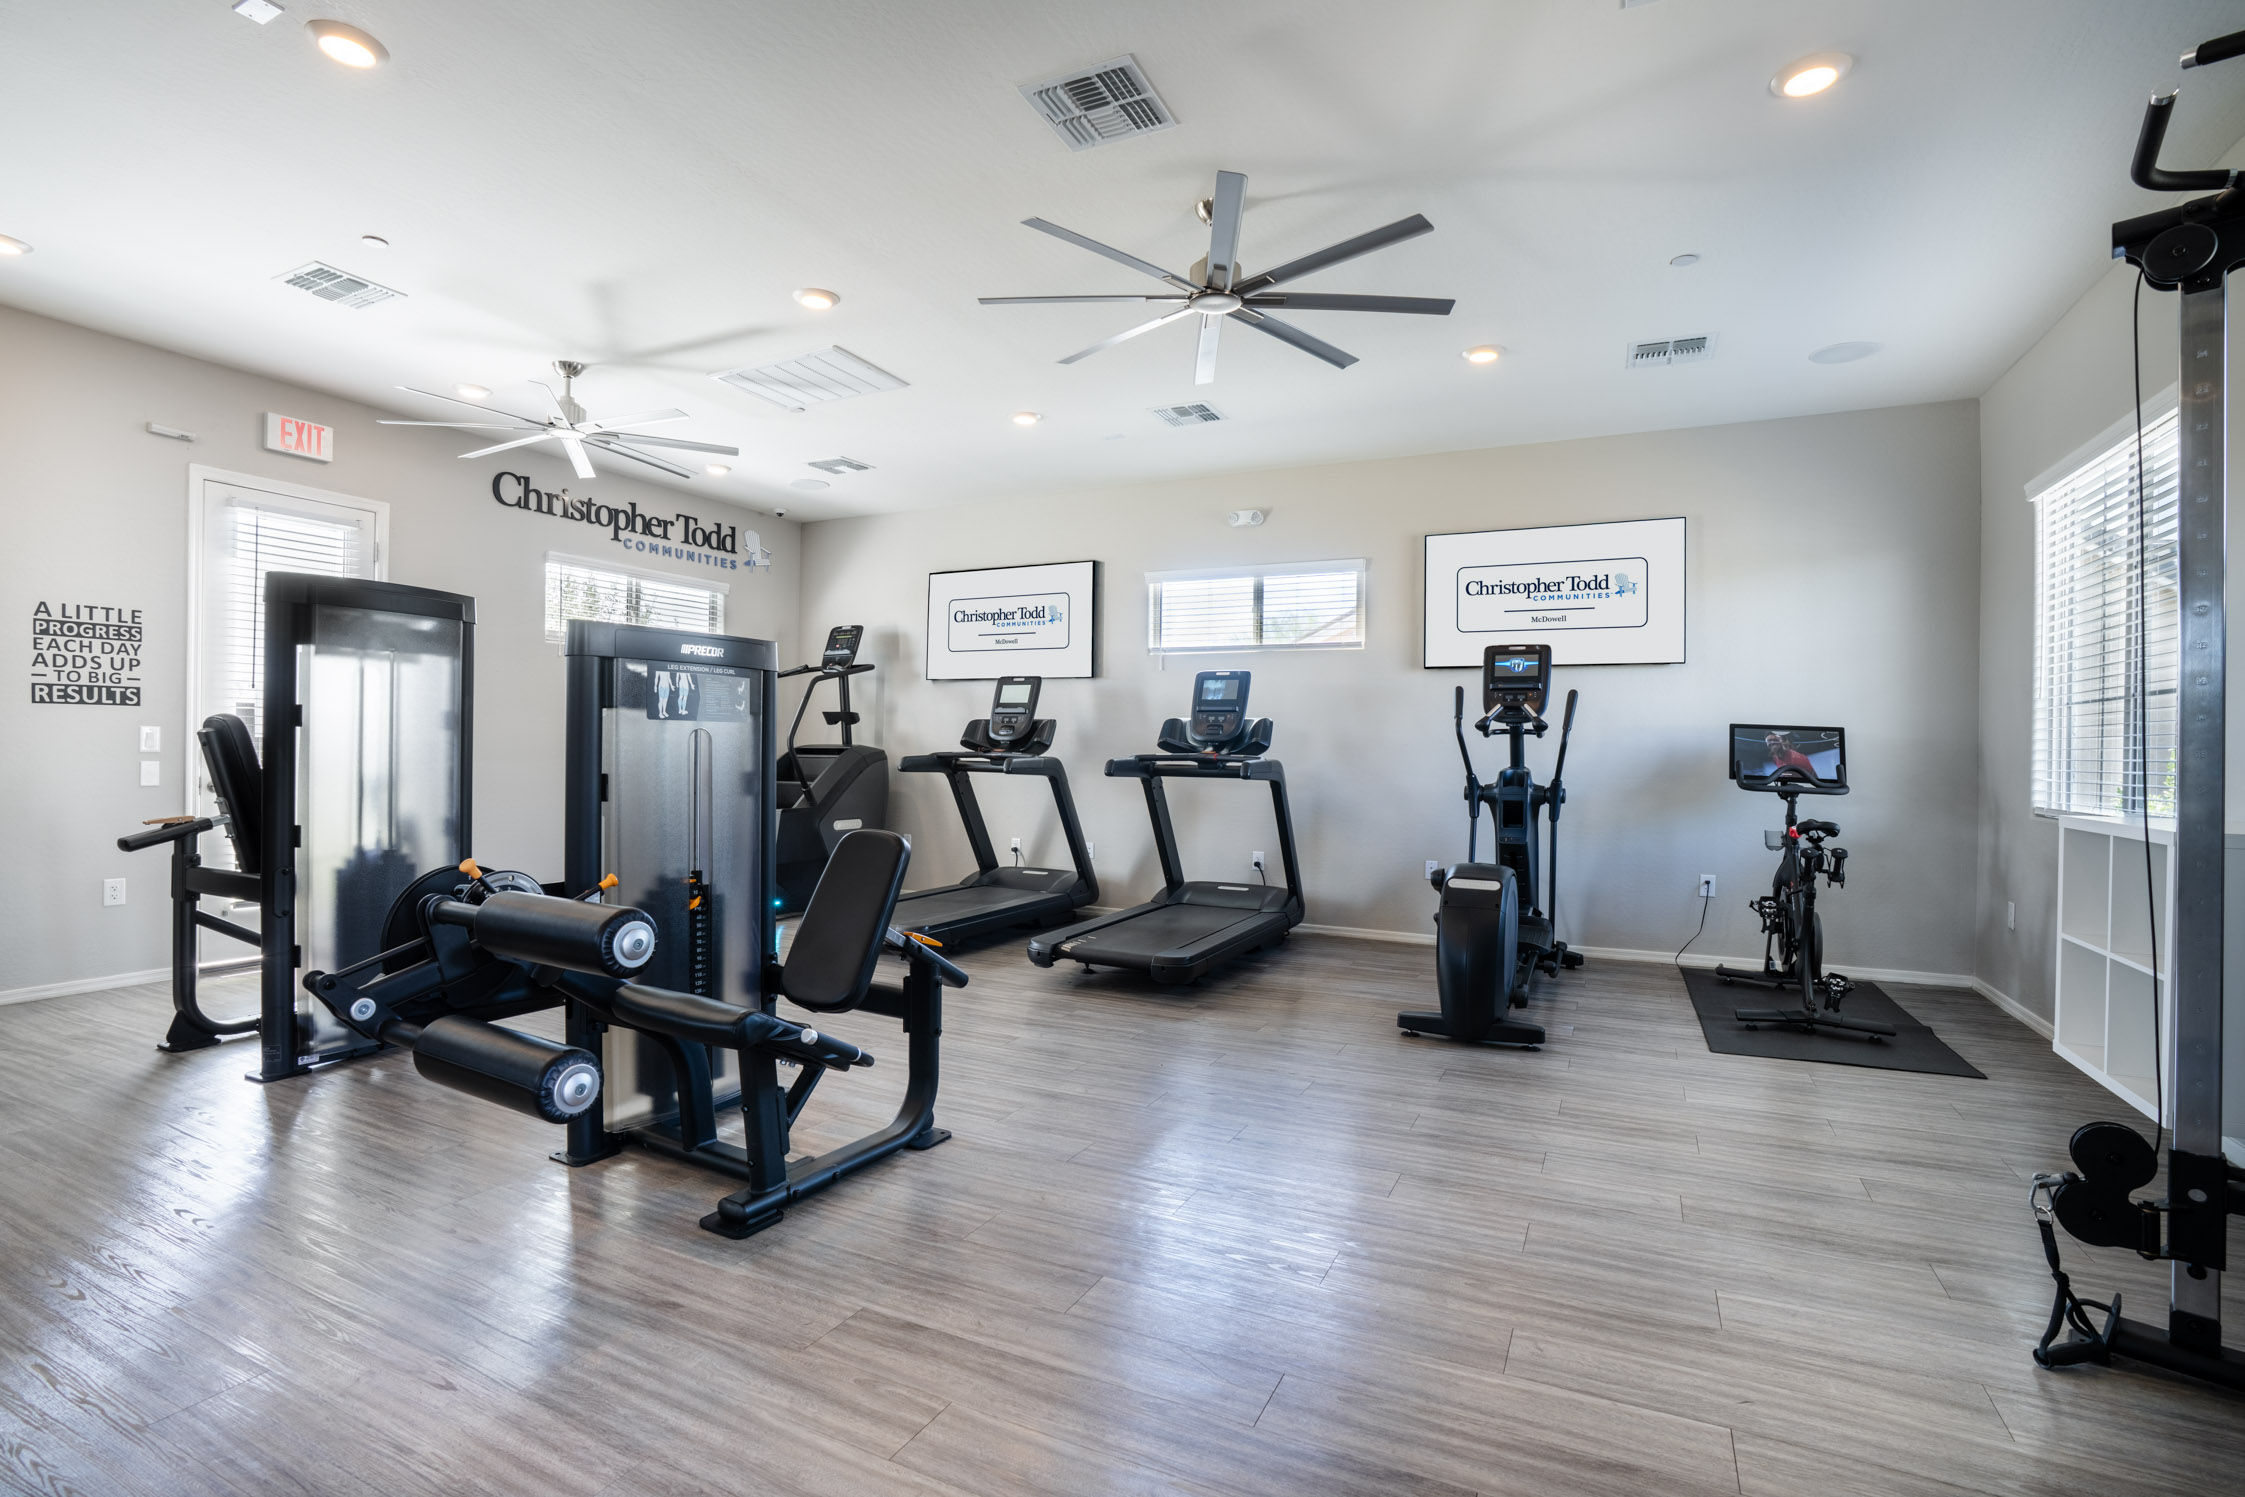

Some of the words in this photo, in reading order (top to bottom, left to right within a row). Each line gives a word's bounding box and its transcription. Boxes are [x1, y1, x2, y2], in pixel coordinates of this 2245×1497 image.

[280, 417, 325, 456] EXIT
[492, 471, 674, 542] Christopher
[676, 514, 738, 554] Todd
[623, 538, 738, 570] COMMUNITIES
[1465, 577, 1565, 600] Christopher
[1565, 574, 1610, 592] Todd
[1533, 592, 1610, 602] COMMUNITIES
[33, 601, 52, 617] A
[61, 603, 142, 625] LITTLE
[954, 607, 1017, 626] Christopher
[1017, 606, 1046, 619] Todd
[1531, 615, 1567, 623] McDowell
[35, 620, 141, 640] PROGRESS
[996, 620, 1046, 628] COMMUNITIES
[33, 637, 93, 654] EACH
[101, 641, 142, 656] DAY
[687, 645, 725, 658] PRECOR
[31, 652, 102, 670] ADDS
[110, 657, 141, 672] UP
[680, 665, 709, 673] EXTENSION
[53, 670, 81, 683] TO
[89, 672, 122, 684] BIG
[35, 685, 139, 705] RESULTS
